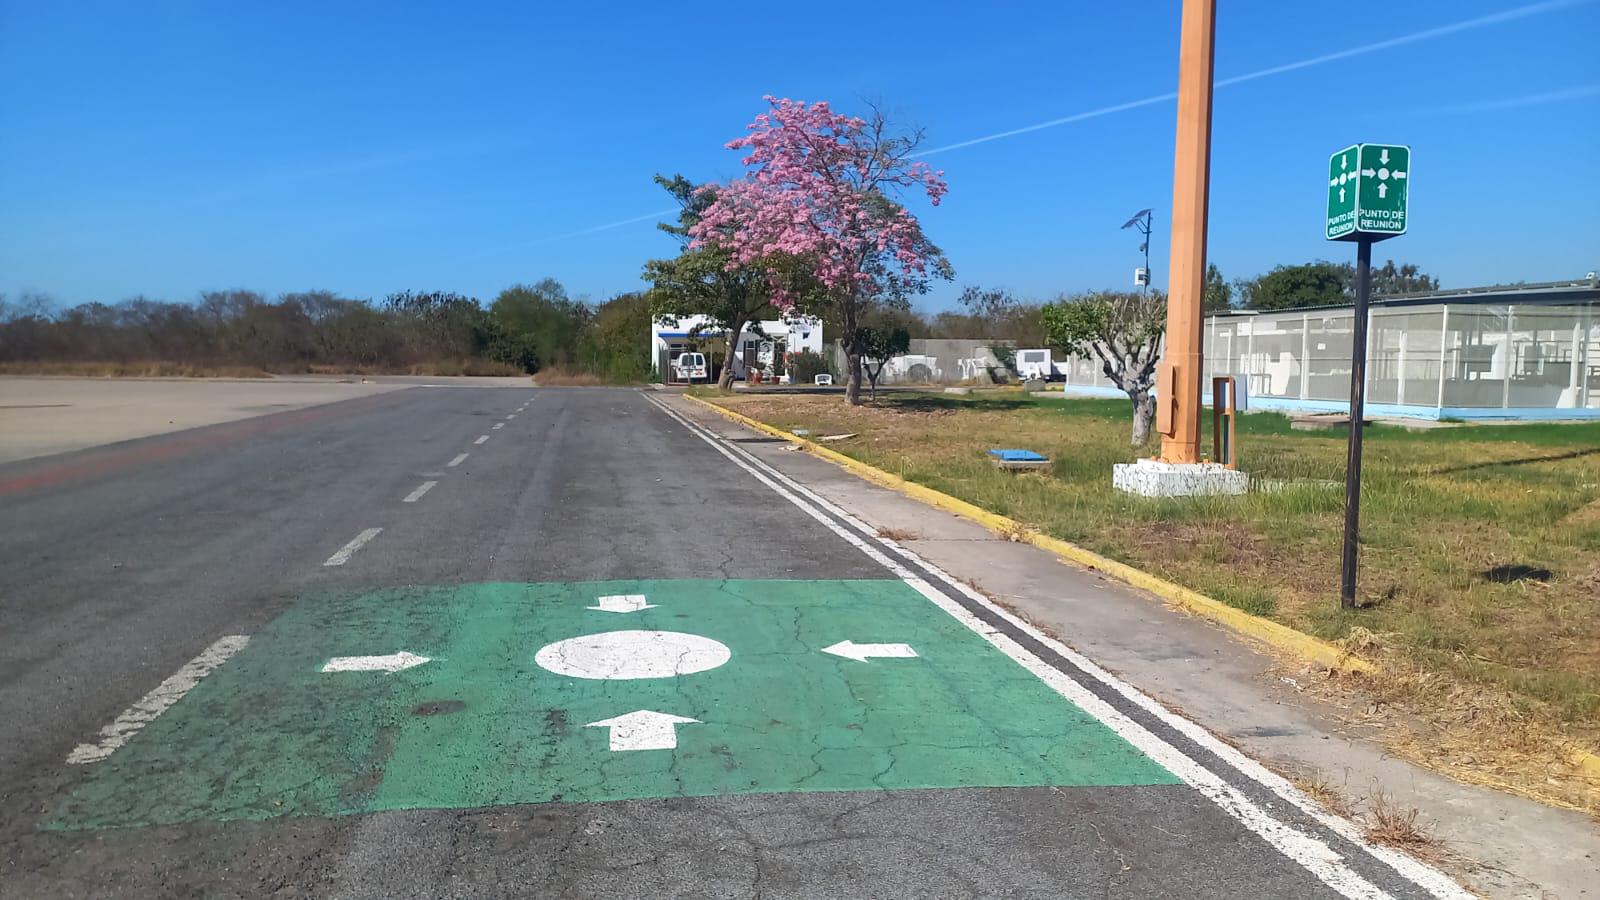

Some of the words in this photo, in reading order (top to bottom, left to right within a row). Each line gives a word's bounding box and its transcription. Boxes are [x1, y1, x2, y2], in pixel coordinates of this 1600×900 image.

[1328, 213, 1347, 225] PUNTO
[1347, 210, 1355, 219] DE
[1359, 209, 1389, 218] PUNTO
[1391, 210, 1405, 219] DE
